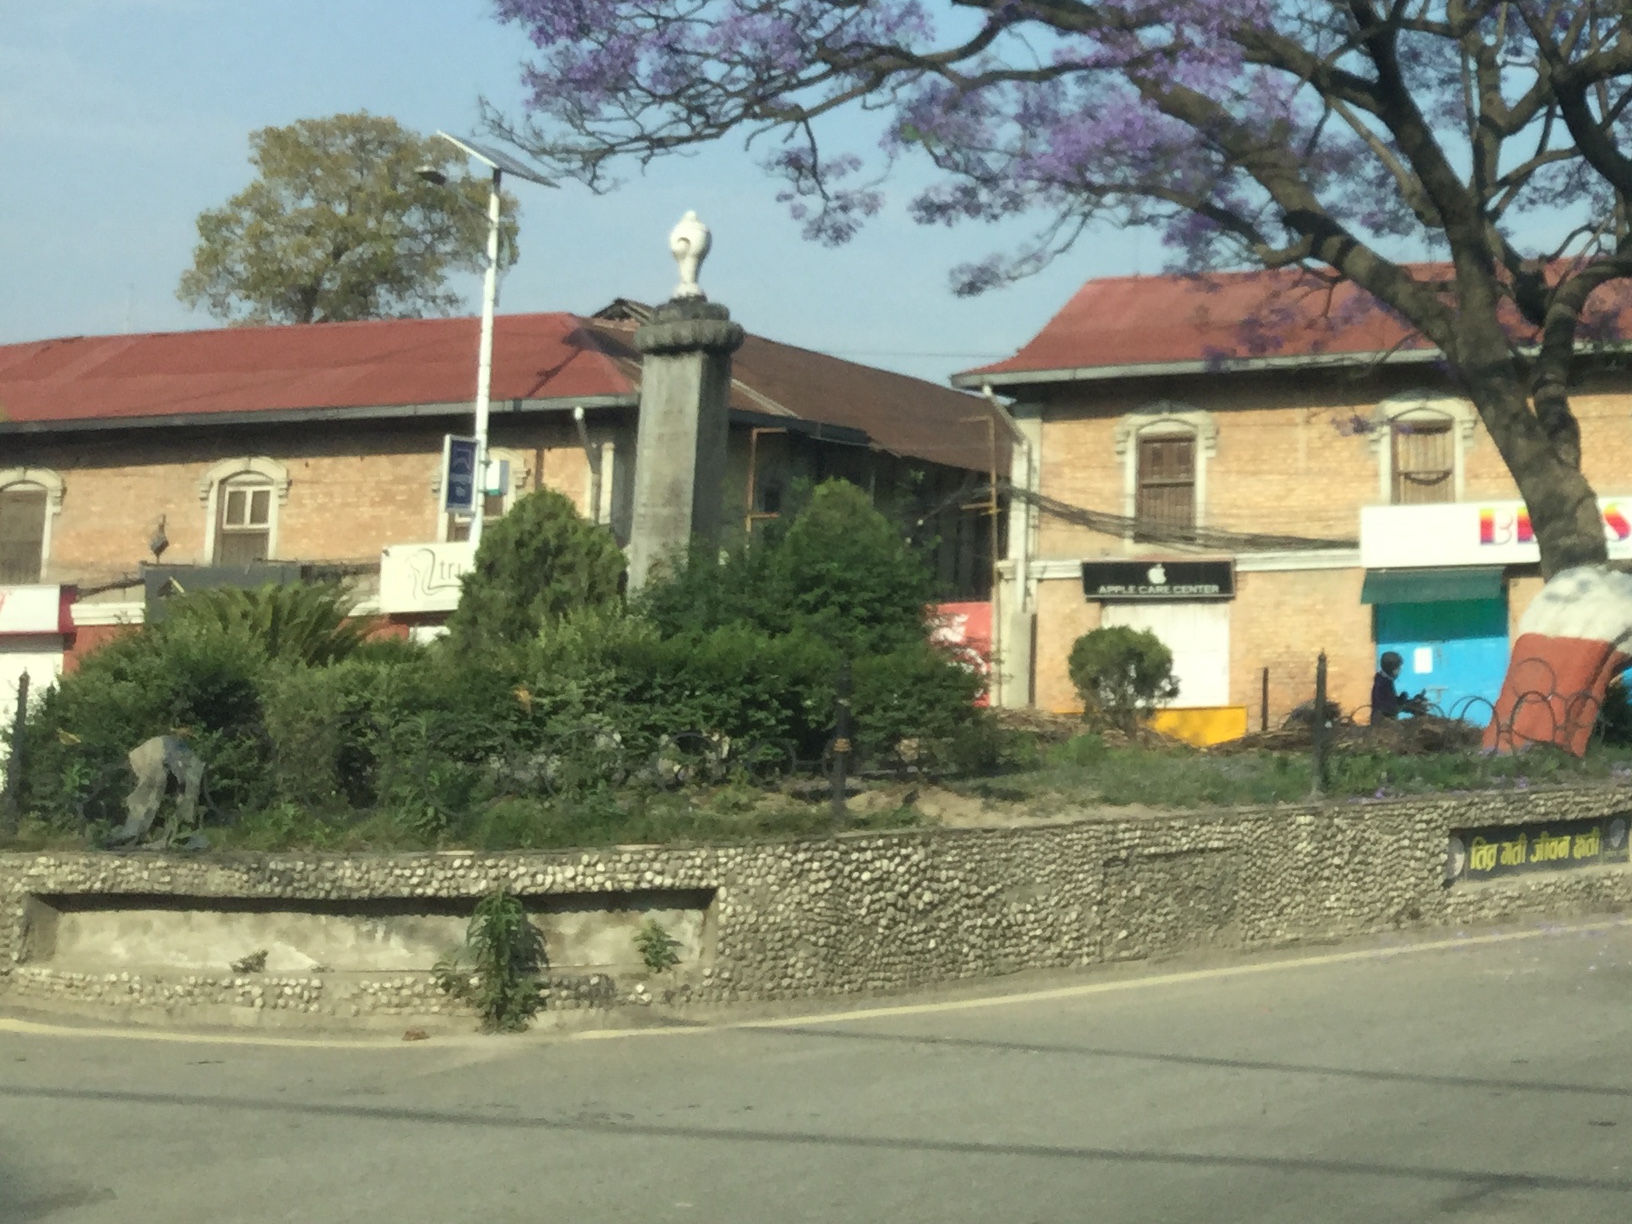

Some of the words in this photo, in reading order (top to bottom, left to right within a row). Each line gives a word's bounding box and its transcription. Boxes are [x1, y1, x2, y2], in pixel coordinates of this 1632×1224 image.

[1099, 586, 1136, 594] APPLE
[1138, 586, 1171, 594] CARE
[1173, 585, 1219, 594] CENTER
